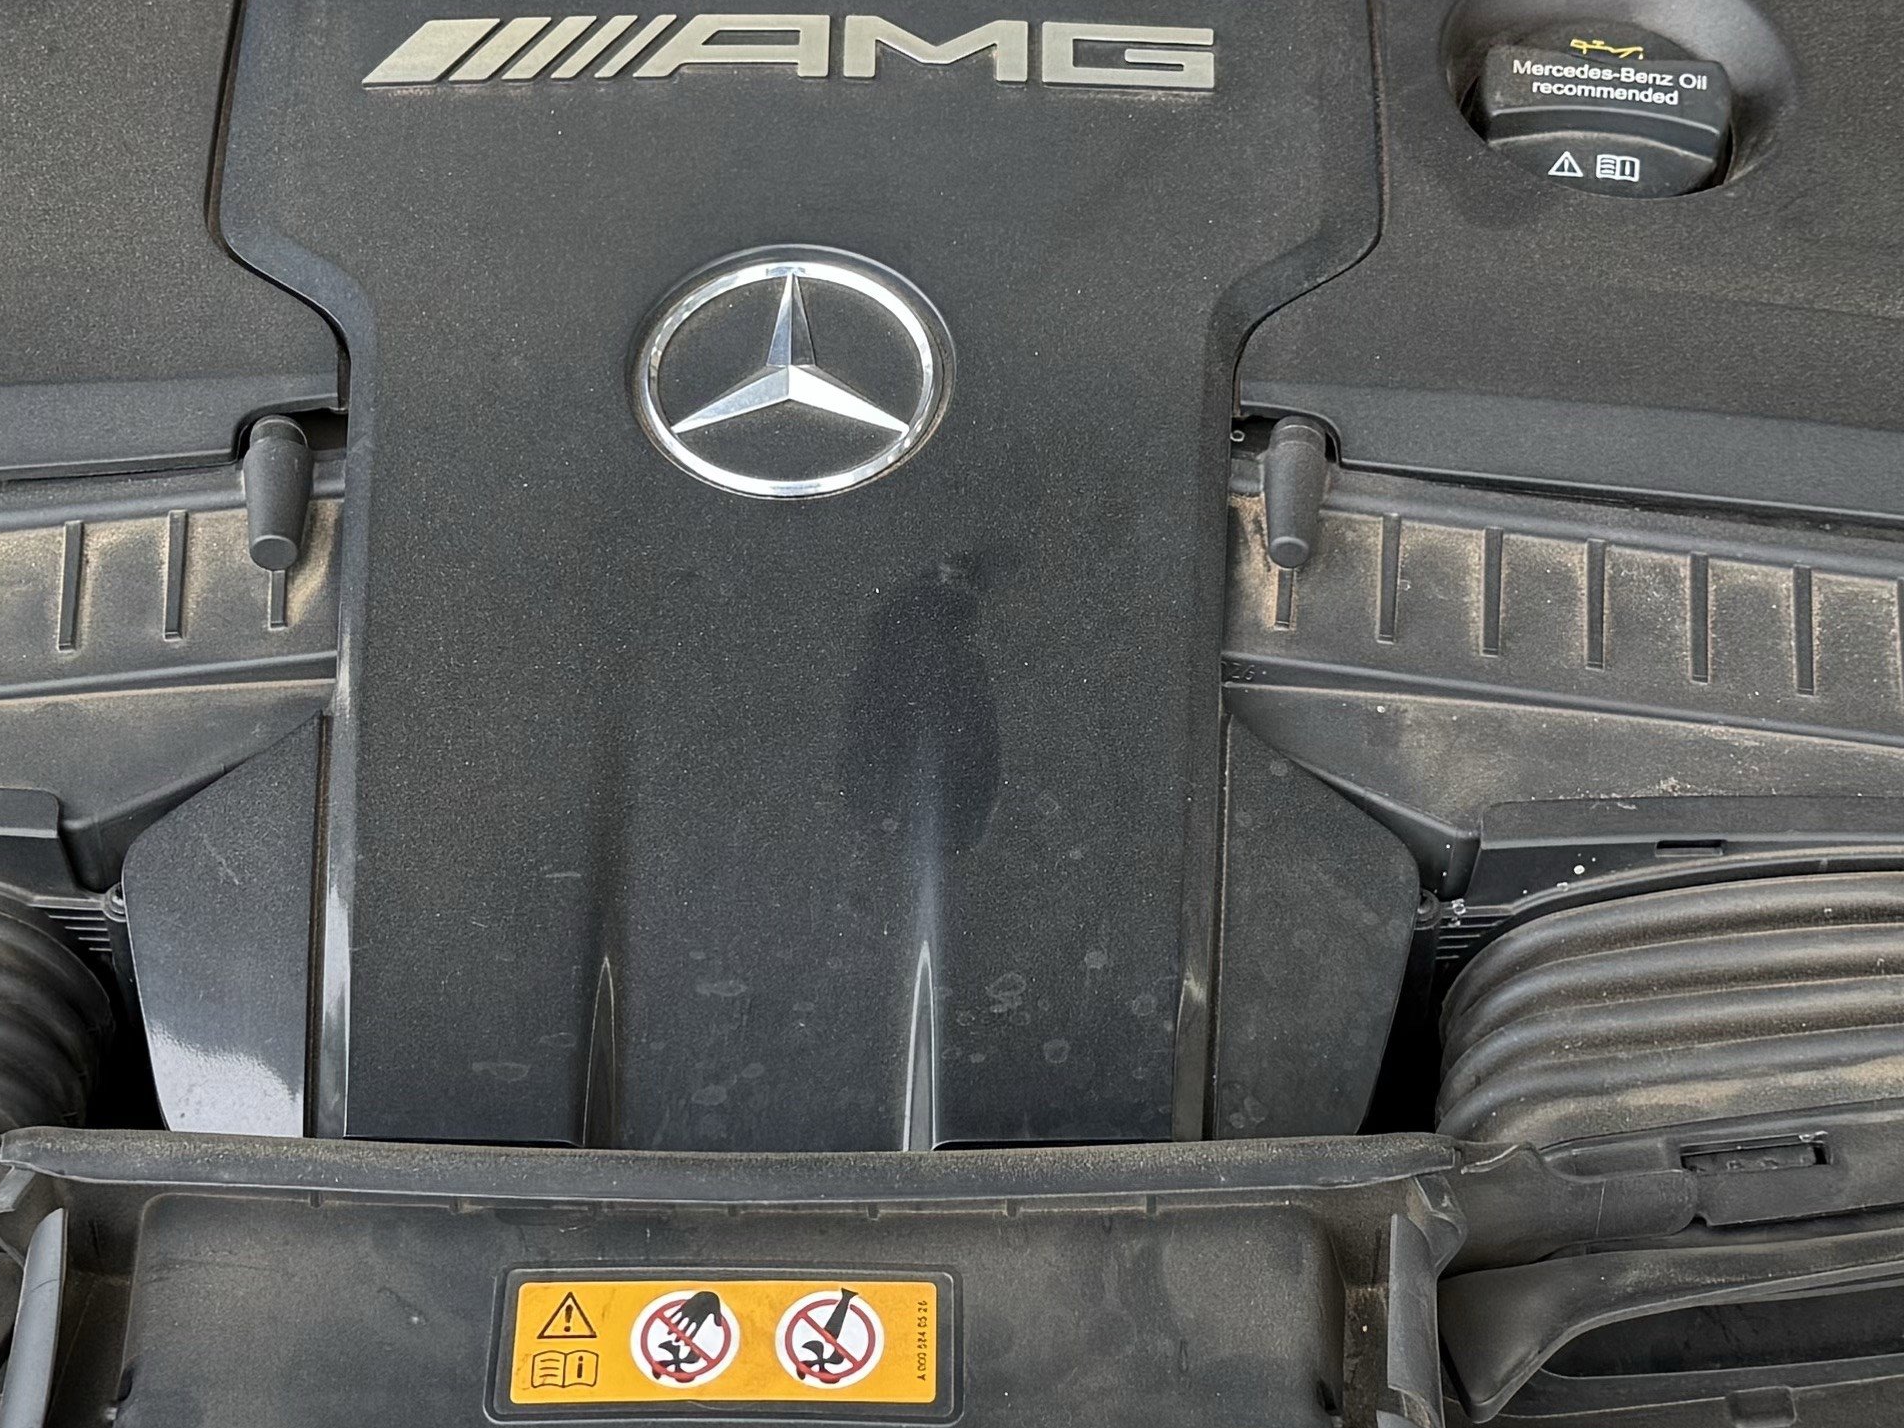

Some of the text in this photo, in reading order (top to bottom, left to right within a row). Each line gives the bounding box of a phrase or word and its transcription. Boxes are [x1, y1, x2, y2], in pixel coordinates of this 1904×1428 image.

[1512, 59, 1708, 91] Mercedes-Benz Oil
[1532, 81, 1679, 106] recommended
